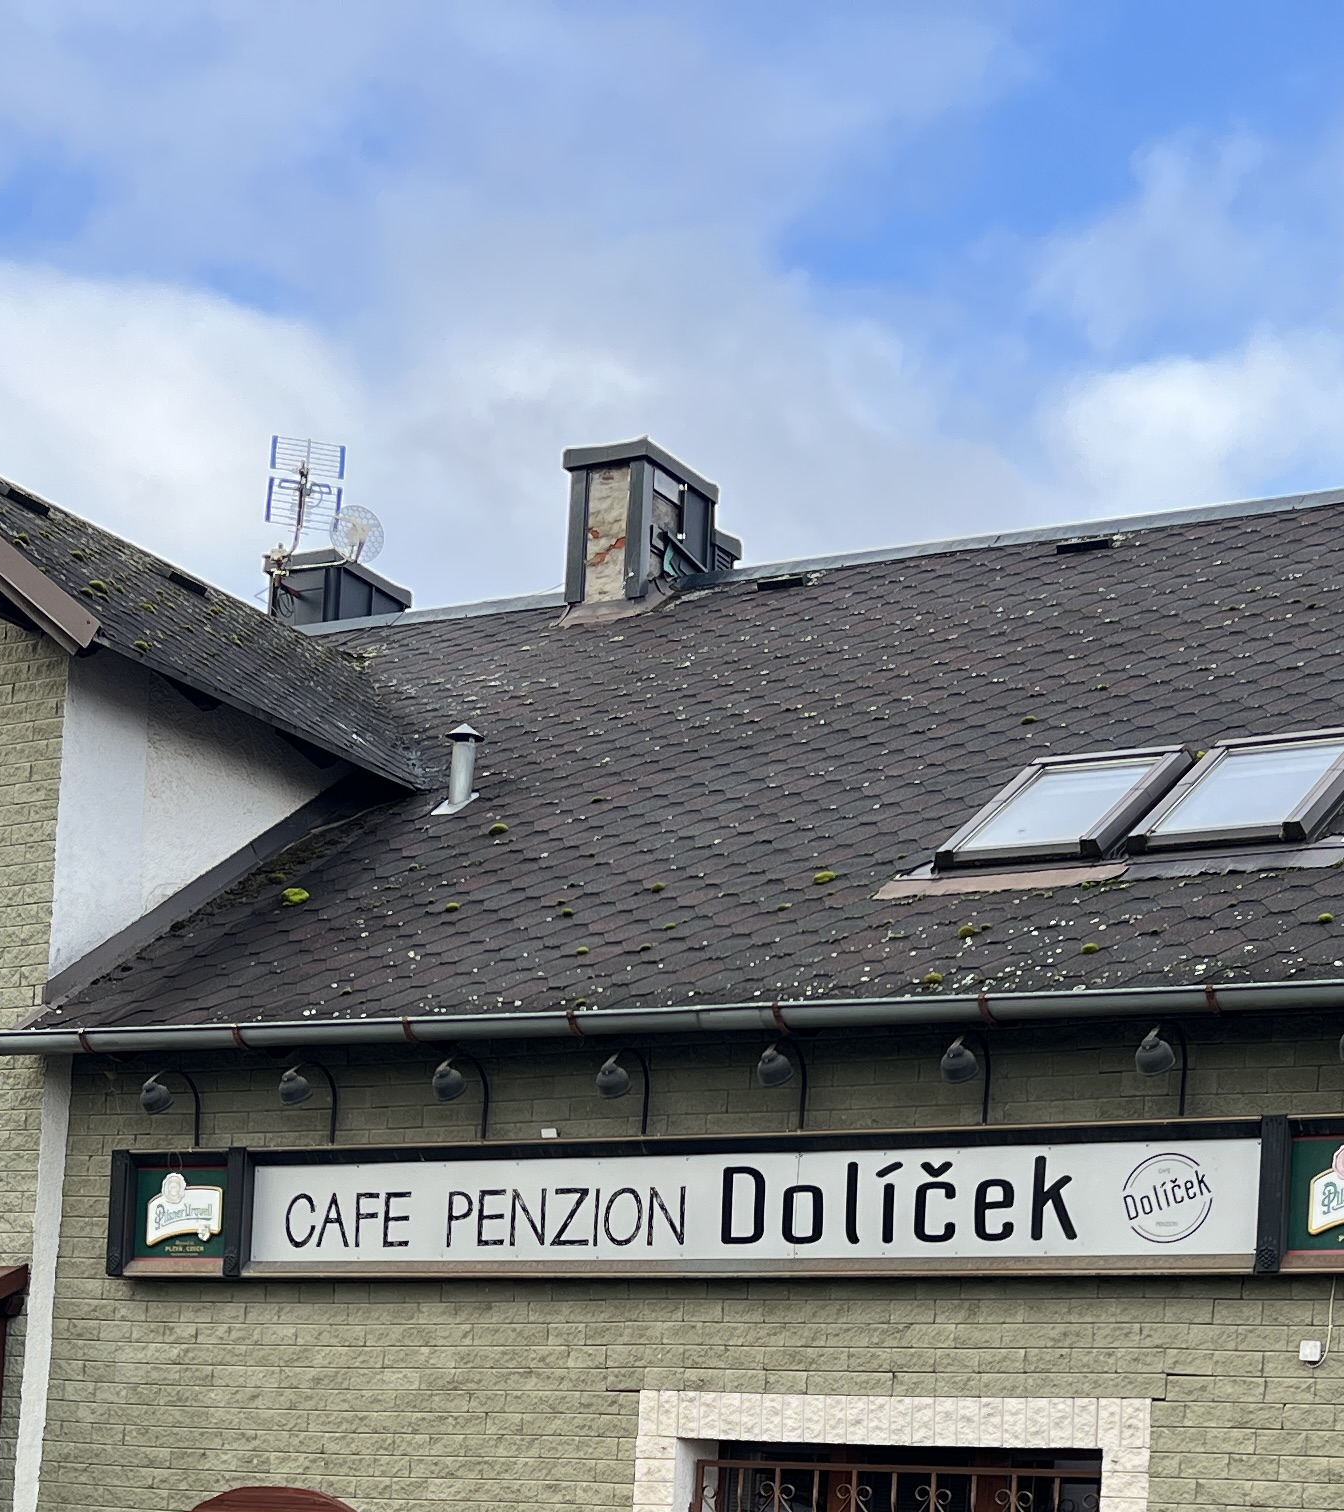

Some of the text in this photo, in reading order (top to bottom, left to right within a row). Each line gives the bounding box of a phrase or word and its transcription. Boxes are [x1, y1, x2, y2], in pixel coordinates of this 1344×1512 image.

[154, 1203, 213, 1230] Pilsner Urquell
[285, 1155, 1078, 1248] CAFE PENZION Dolíček
[1123, 1170, 1211, 1221] Dolíček
